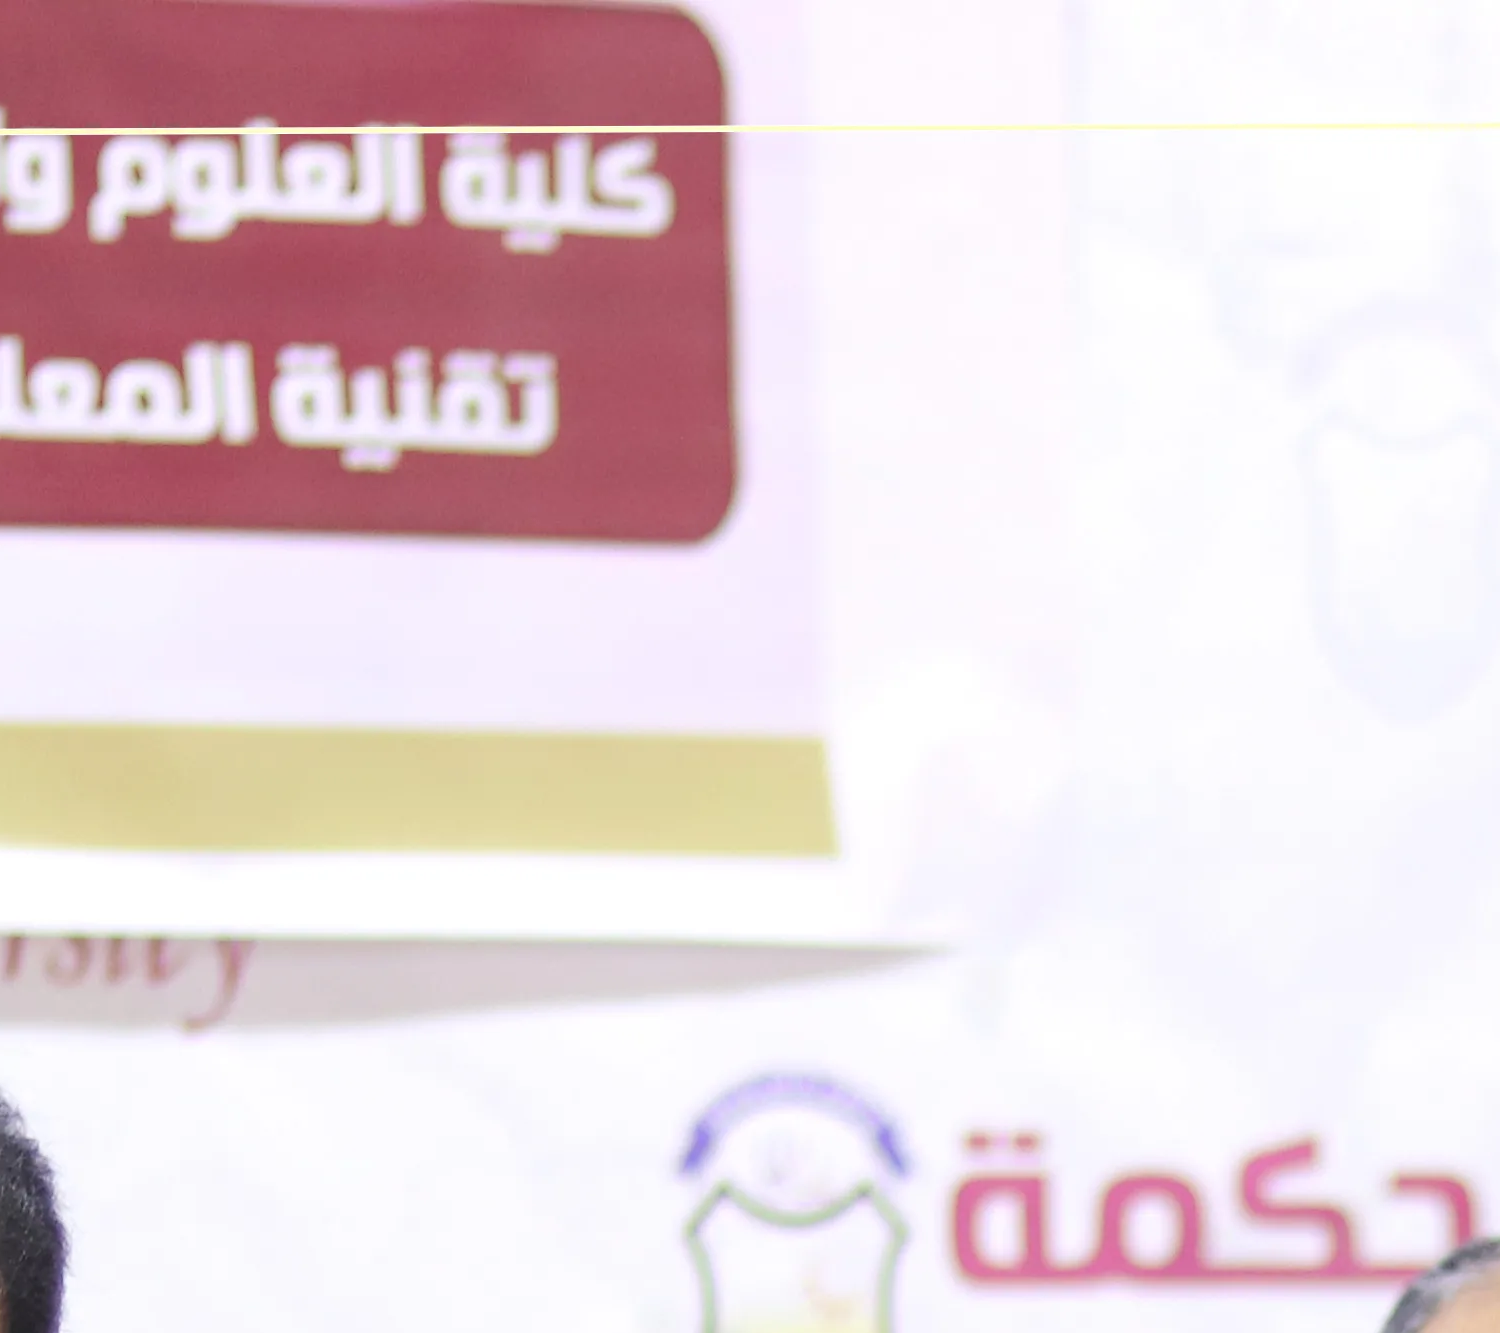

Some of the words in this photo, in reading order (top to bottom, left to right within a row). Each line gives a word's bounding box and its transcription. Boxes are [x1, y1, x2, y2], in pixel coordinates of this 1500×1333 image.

[86, 117, 424, 243] العلوم
[440, 130, 674, 252] كلية
[271, 346, 558, 470] تقنية
